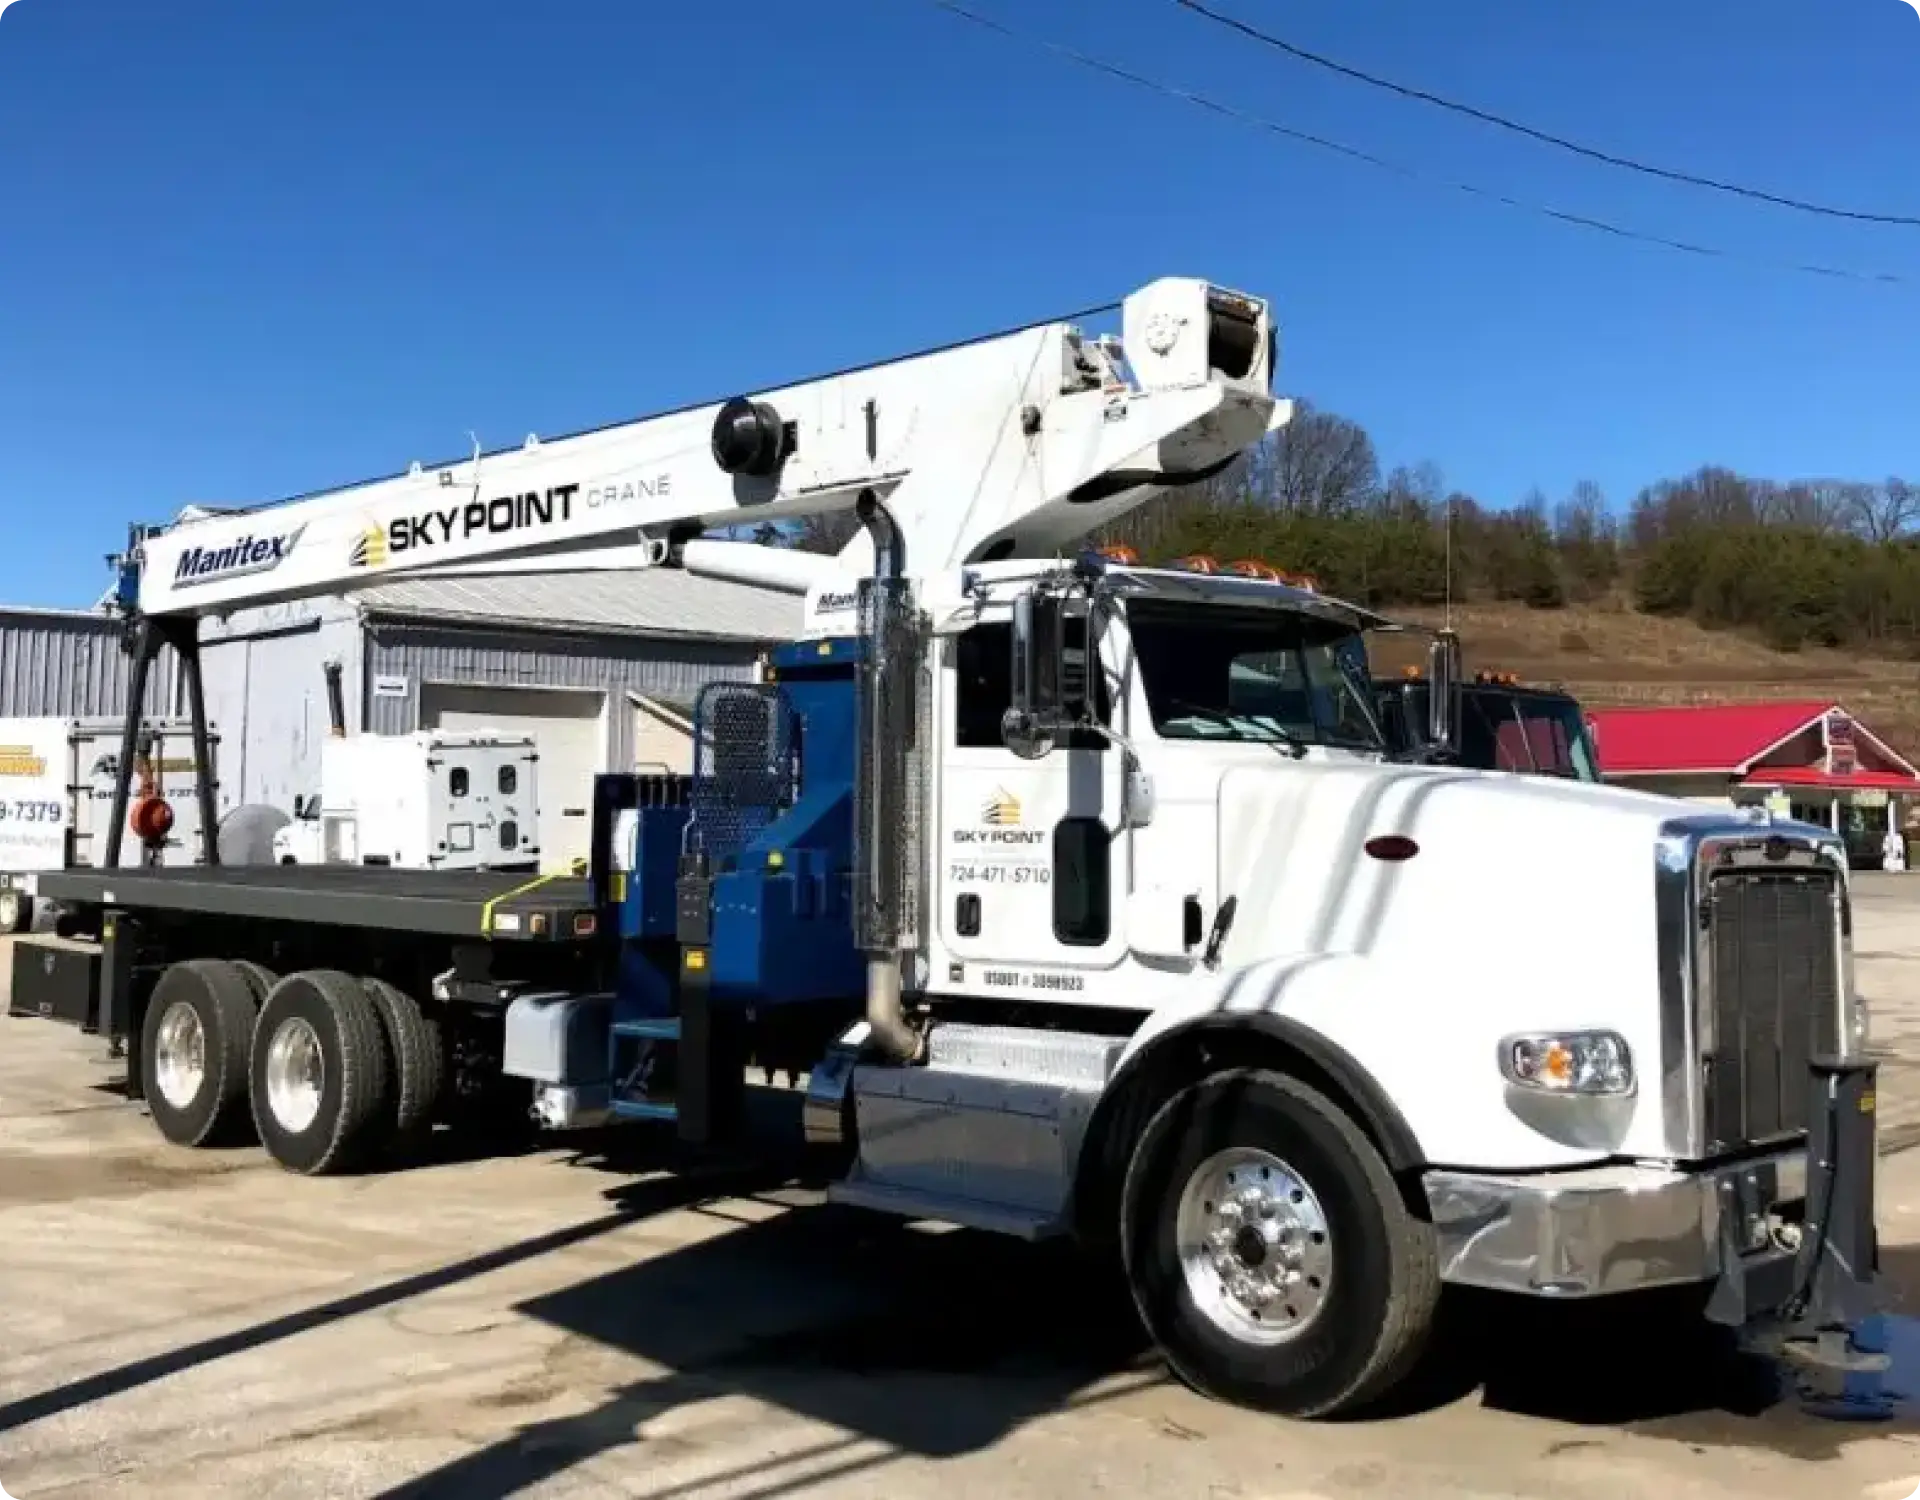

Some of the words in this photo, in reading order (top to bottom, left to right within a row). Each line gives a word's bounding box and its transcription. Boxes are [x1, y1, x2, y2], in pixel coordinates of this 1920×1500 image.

[586, 474, 671, 508] CRANE
[174, 533, 286, 578] Manitex
[949, 864, 1051, 885] 724-471-5710
